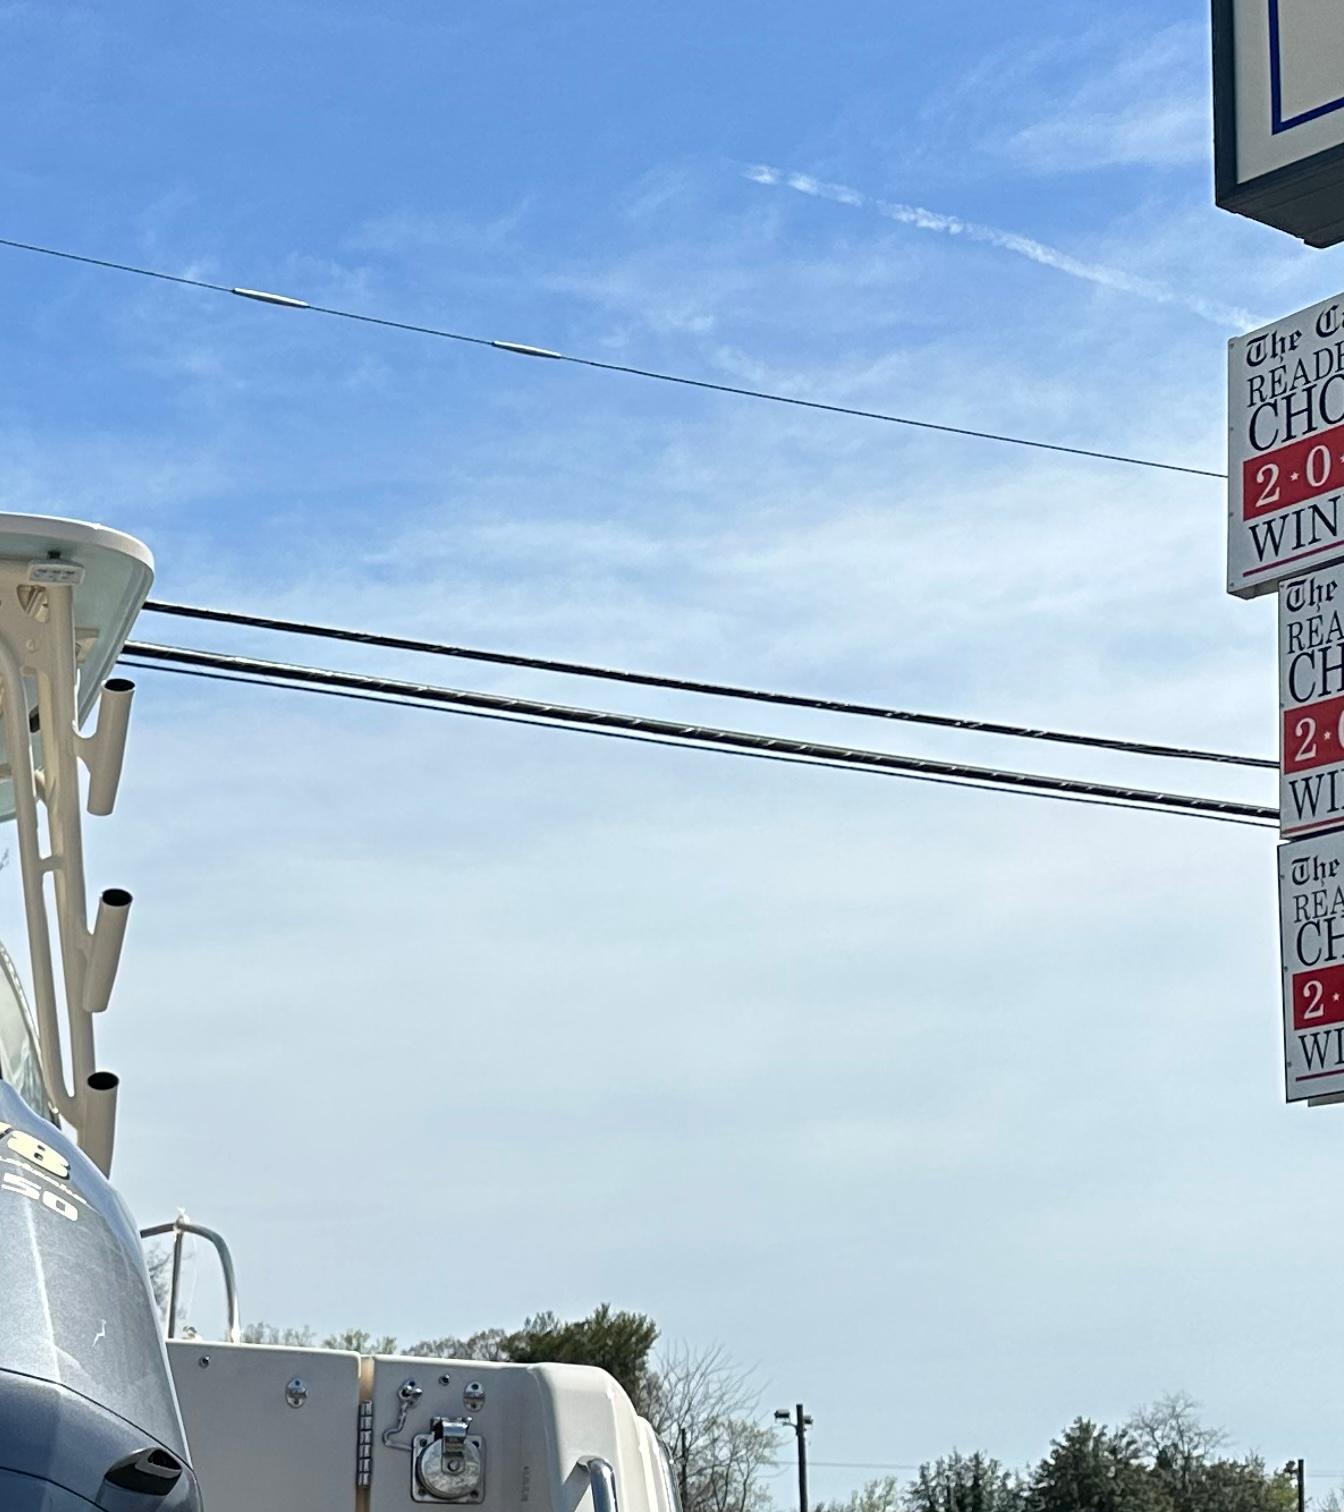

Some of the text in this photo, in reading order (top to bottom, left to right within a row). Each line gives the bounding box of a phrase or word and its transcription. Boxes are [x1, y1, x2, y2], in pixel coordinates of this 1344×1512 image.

[1246, 304, 1344, 367] The C
[1248, 374, 1344, 451] CHO
[1249, 494, 1344, 562] WIN
[1286, 577, 1338, 612] The
[1287, 609, 1344, 654] REA
[1289, 767, 1344, 820] WI
[1292, 855, 1340, 887] The
